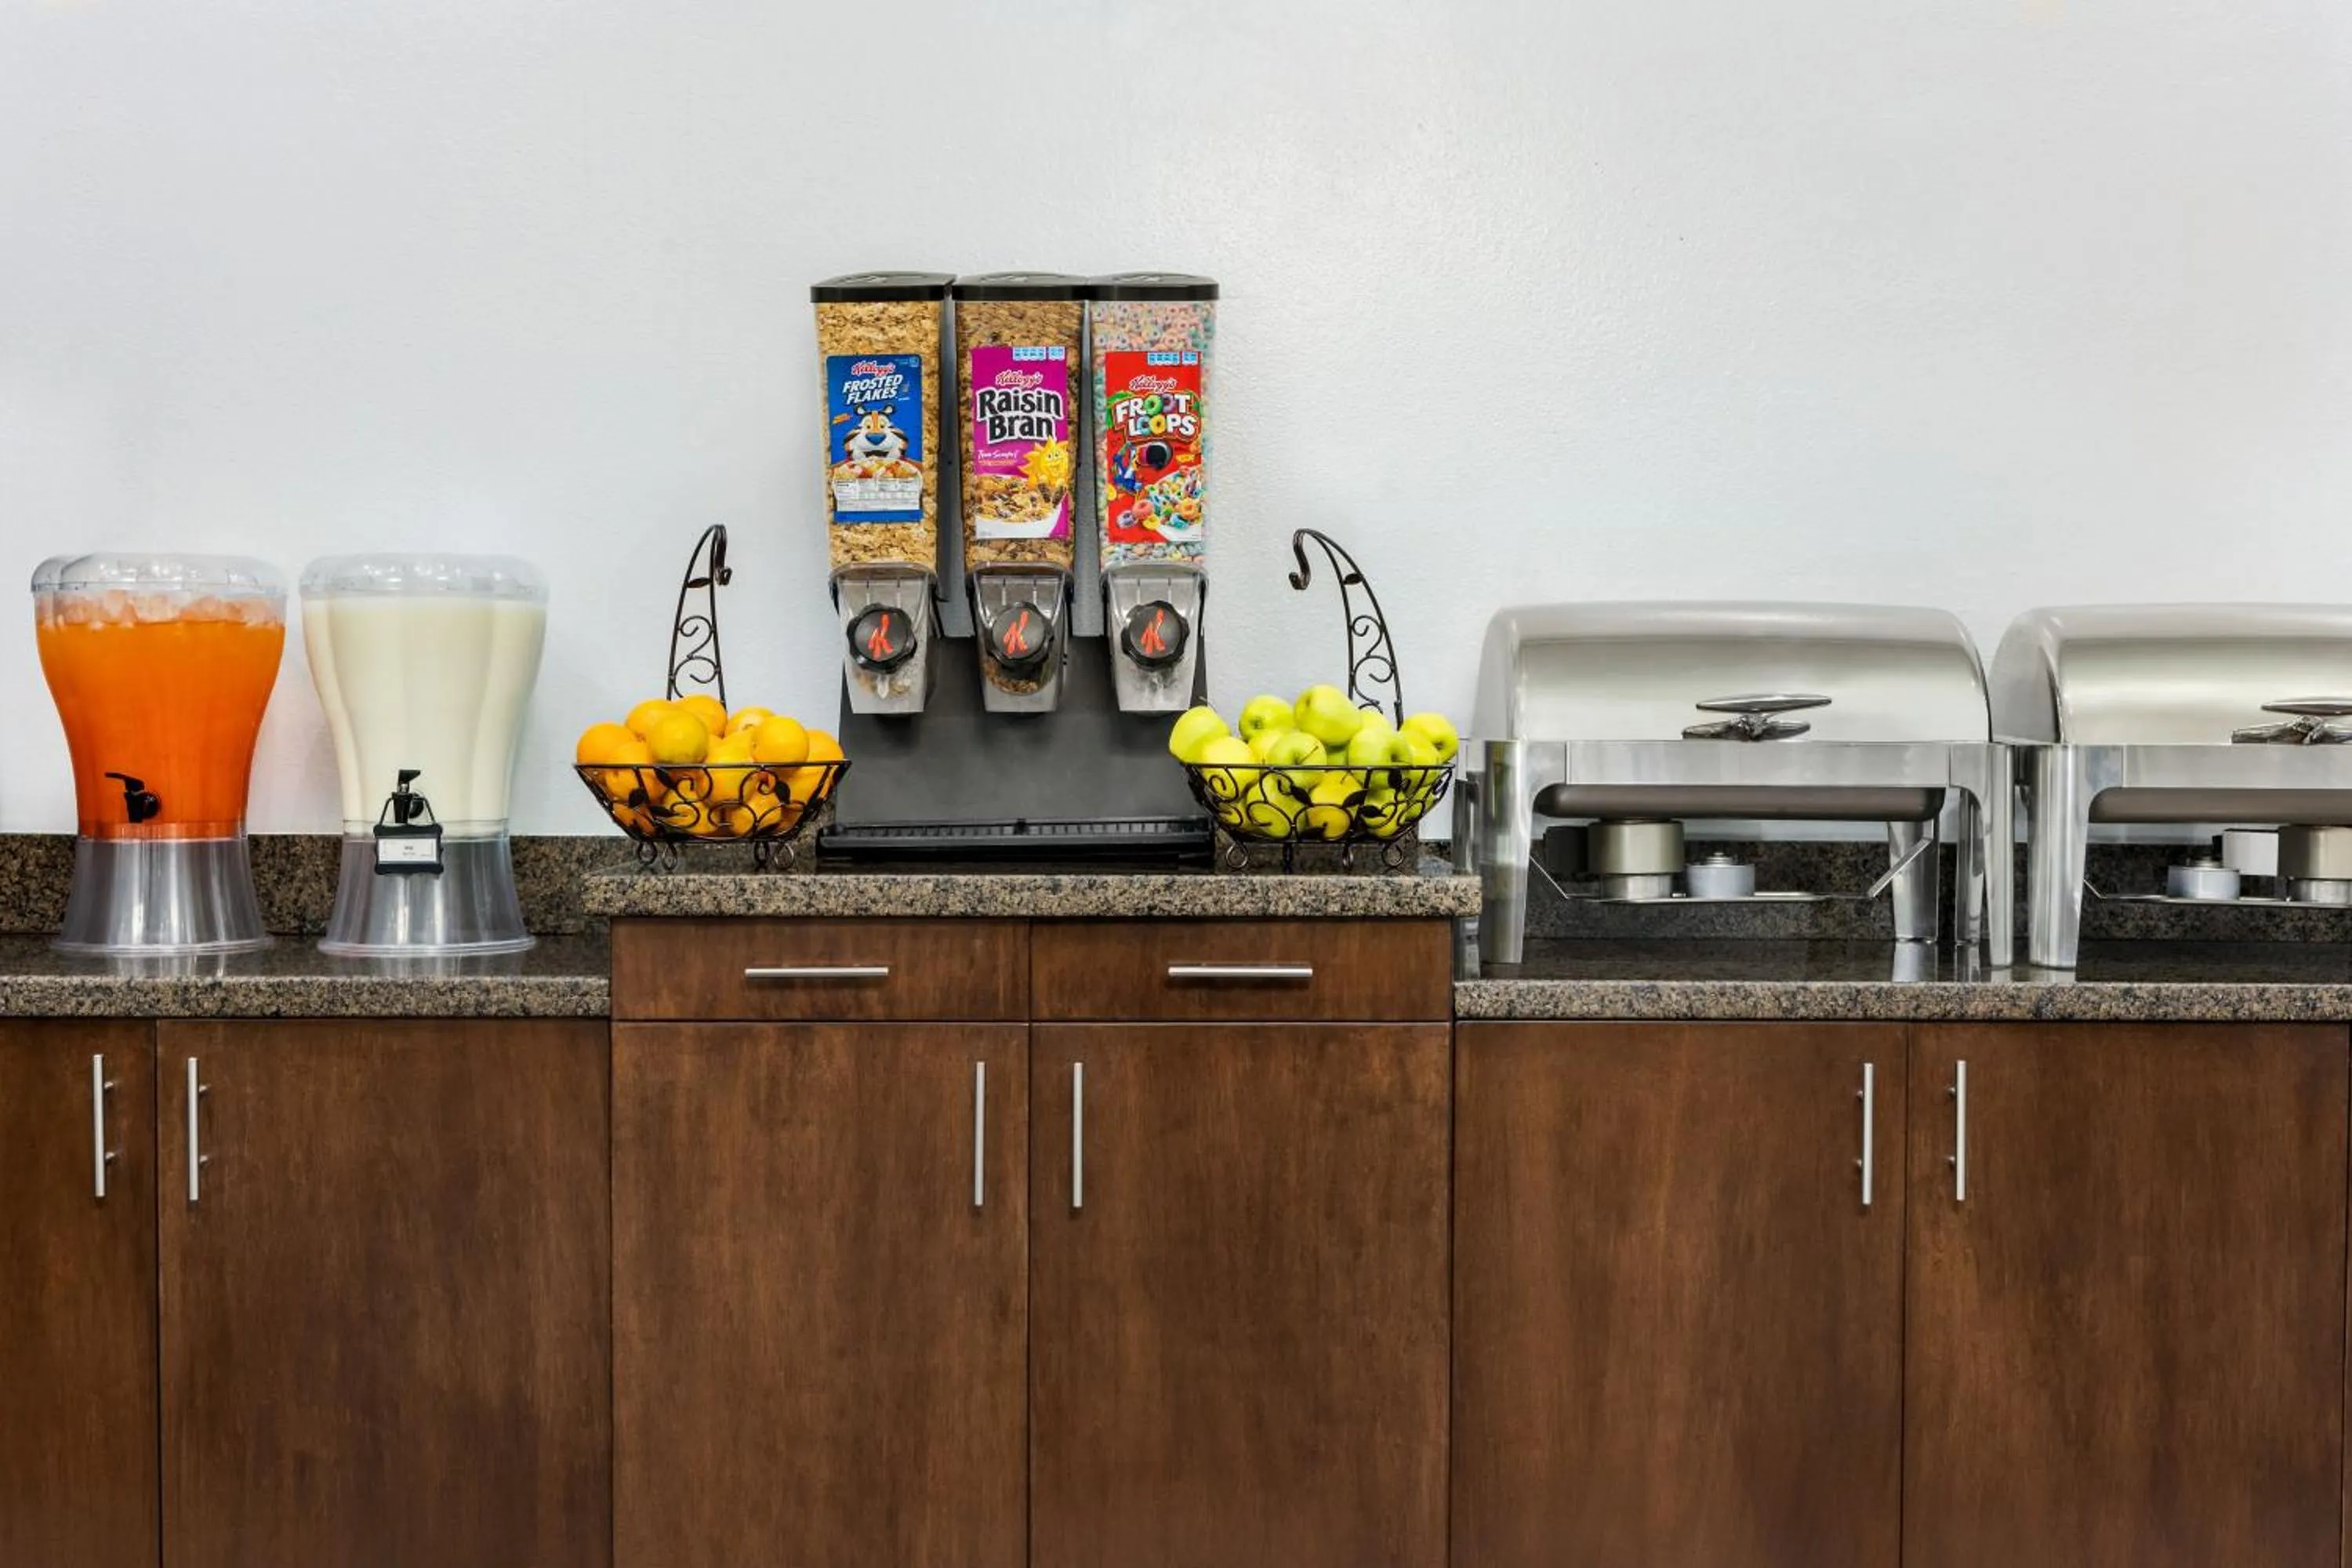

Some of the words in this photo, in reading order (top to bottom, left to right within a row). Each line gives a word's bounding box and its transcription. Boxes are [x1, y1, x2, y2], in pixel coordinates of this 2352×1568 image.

[842, 375, 903, 394] FROSTED
[846, 386, 898, 405] FLAKES
[978, 388, 1063, 419] Raisin
[1115, 394, 1190, 424] FROOT
[988, 414, 1055, 441] Bran
[1128, 414, 1197, 437] LOOPS
